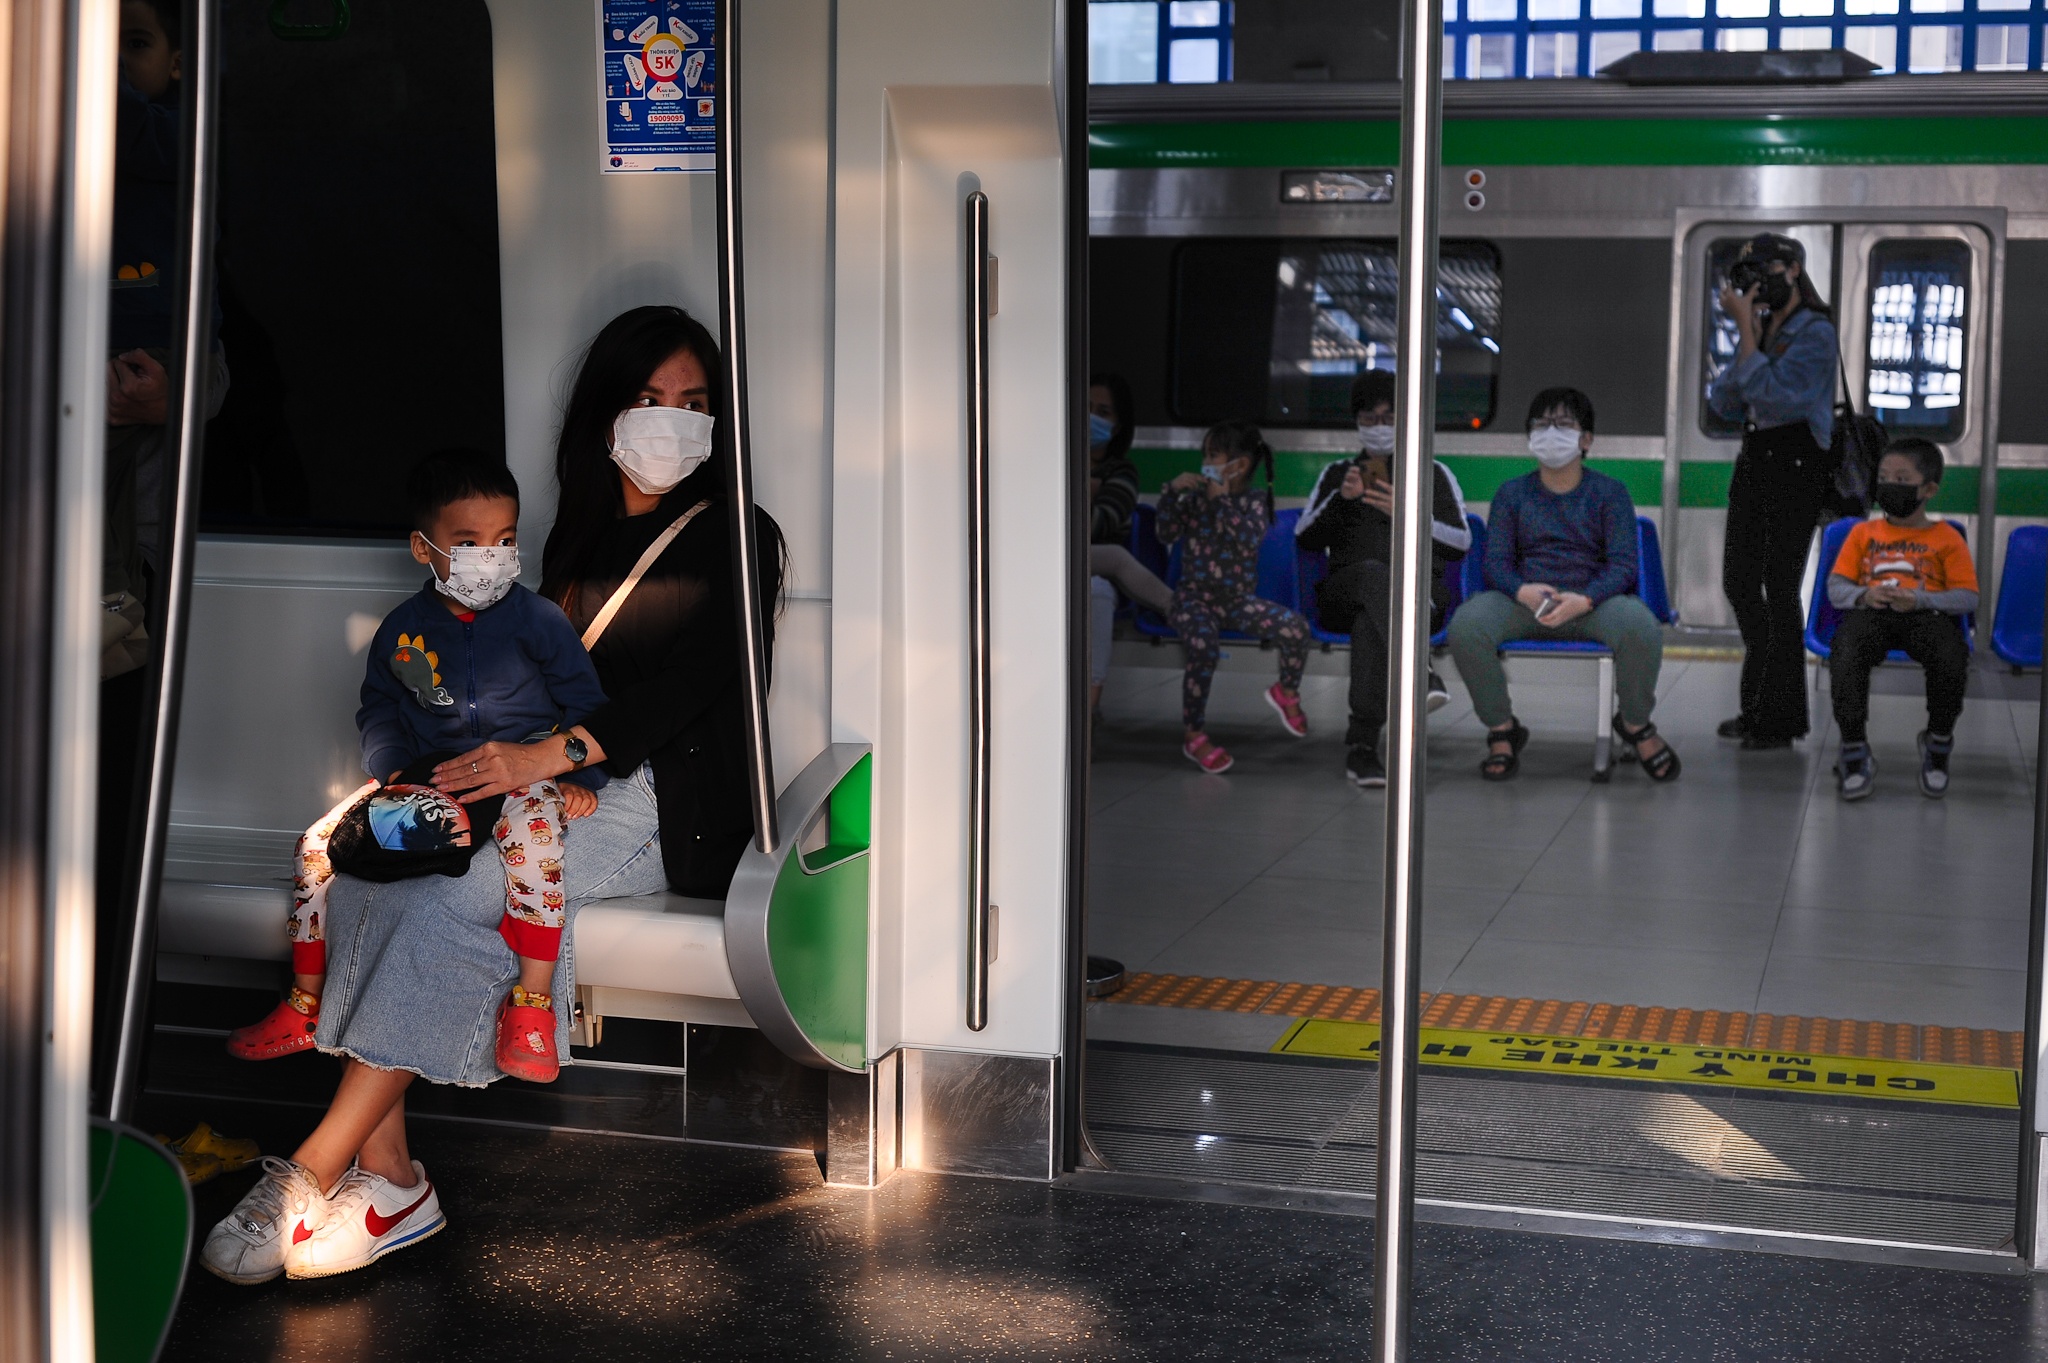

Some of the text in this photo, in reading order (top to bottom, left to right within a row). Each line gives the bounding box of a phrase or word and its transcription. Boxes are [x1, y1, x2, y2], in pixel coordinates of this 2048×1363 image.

[655, 56, 675, 69] 5K
[1489, 1036, 1811, 1066] MIND THE GAP
[1502, 1048, 1660, 1071] KHE
[1689, 1062, 1734, 1078] Ý
[1768, 1068, 1936, 1091] CHÚ
